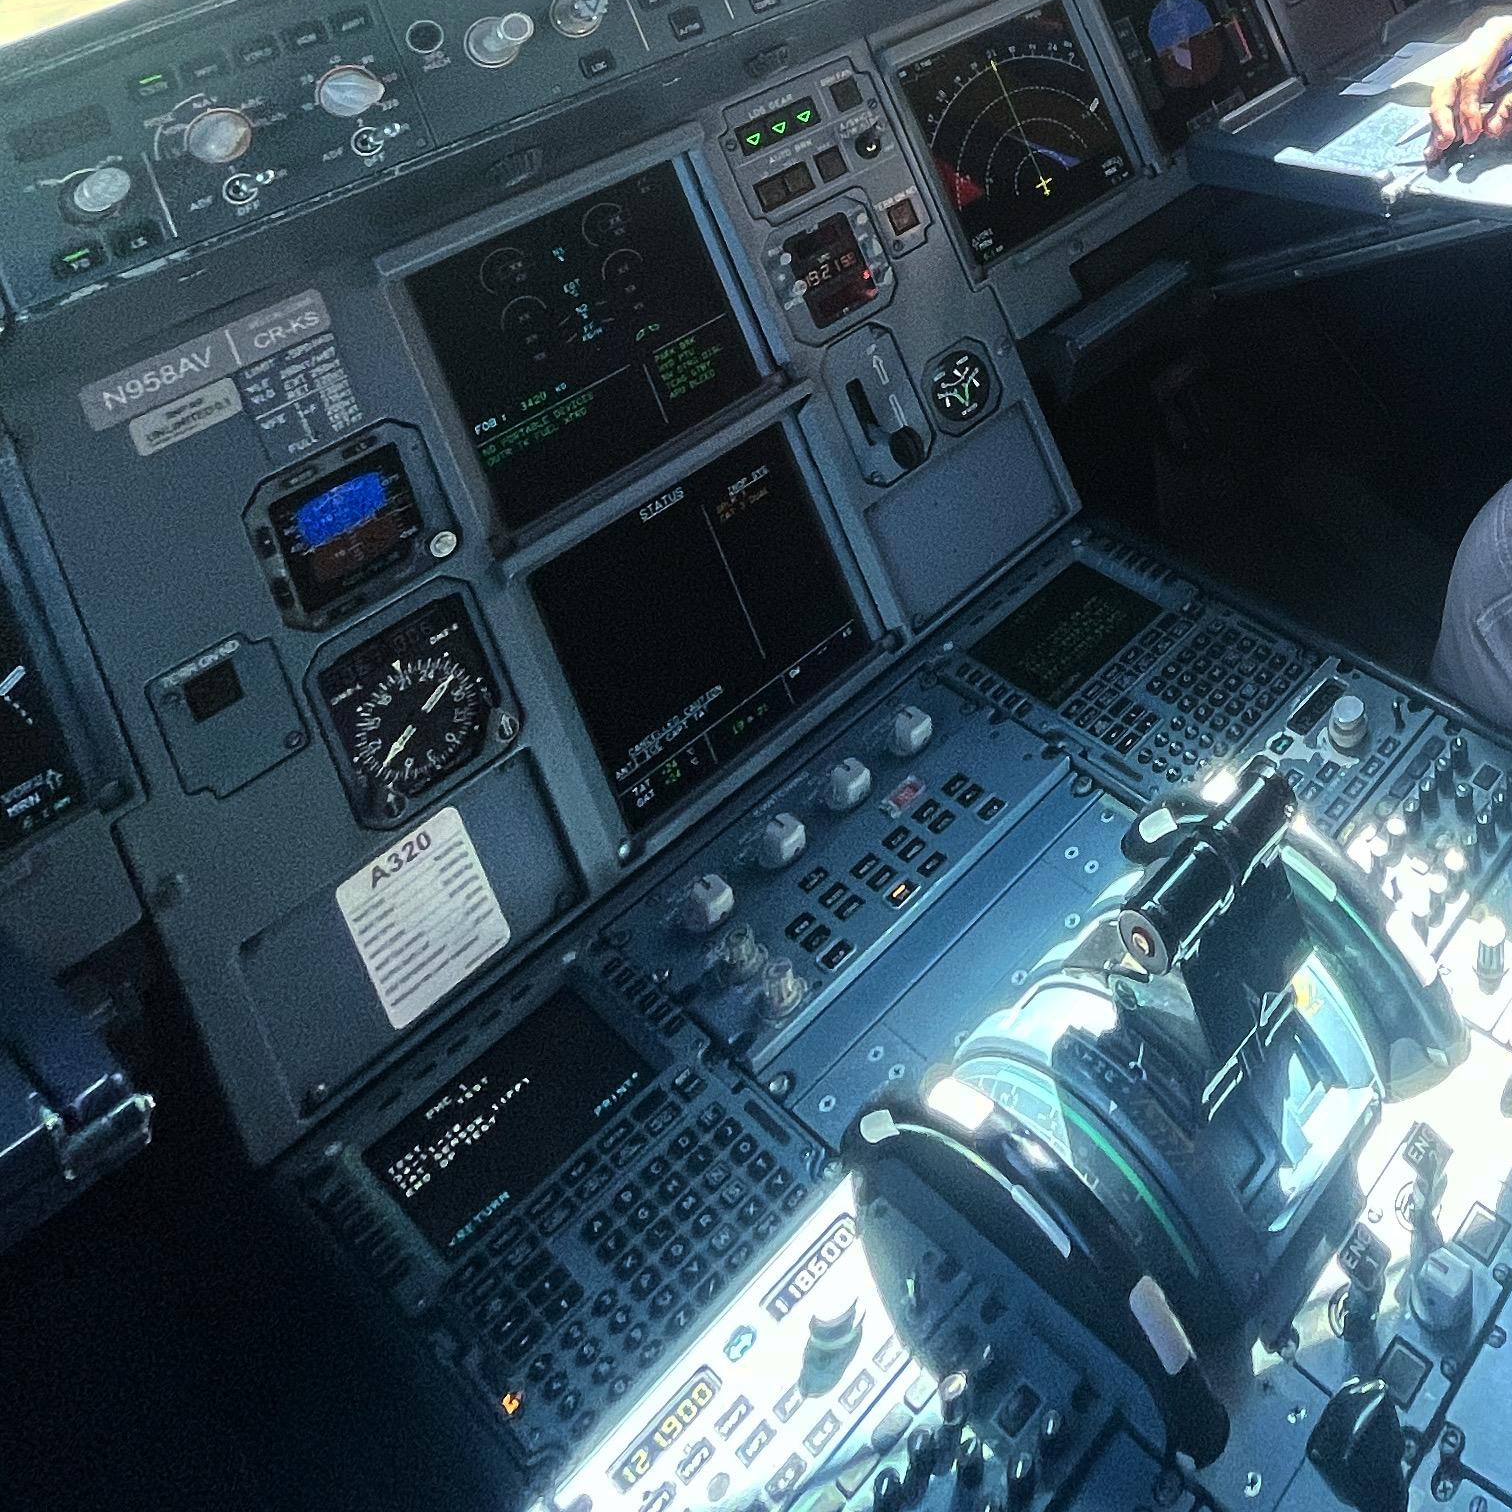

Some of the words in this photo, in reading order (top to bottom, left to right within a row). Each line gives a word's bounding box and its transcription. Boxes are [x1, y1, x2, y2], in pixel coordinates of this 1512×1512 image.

[768, 92, 794, 113] GEAR
[768, 147, 792, 166] AUTO
[236, 199, 261, 217] OFF
[254, 310, 322, 350] CR-KS
[102, 345, 212, 411] N958AV
[474, 416, 497, 437] FOB
[520, 391, 548, 412] 3420
[500, 415, 551, 447] PORTABLE
[552, 392, 595, 420] DEVICES
[639, 486, 685, 523] STATUS
[371, 829, 432, 890] A320
